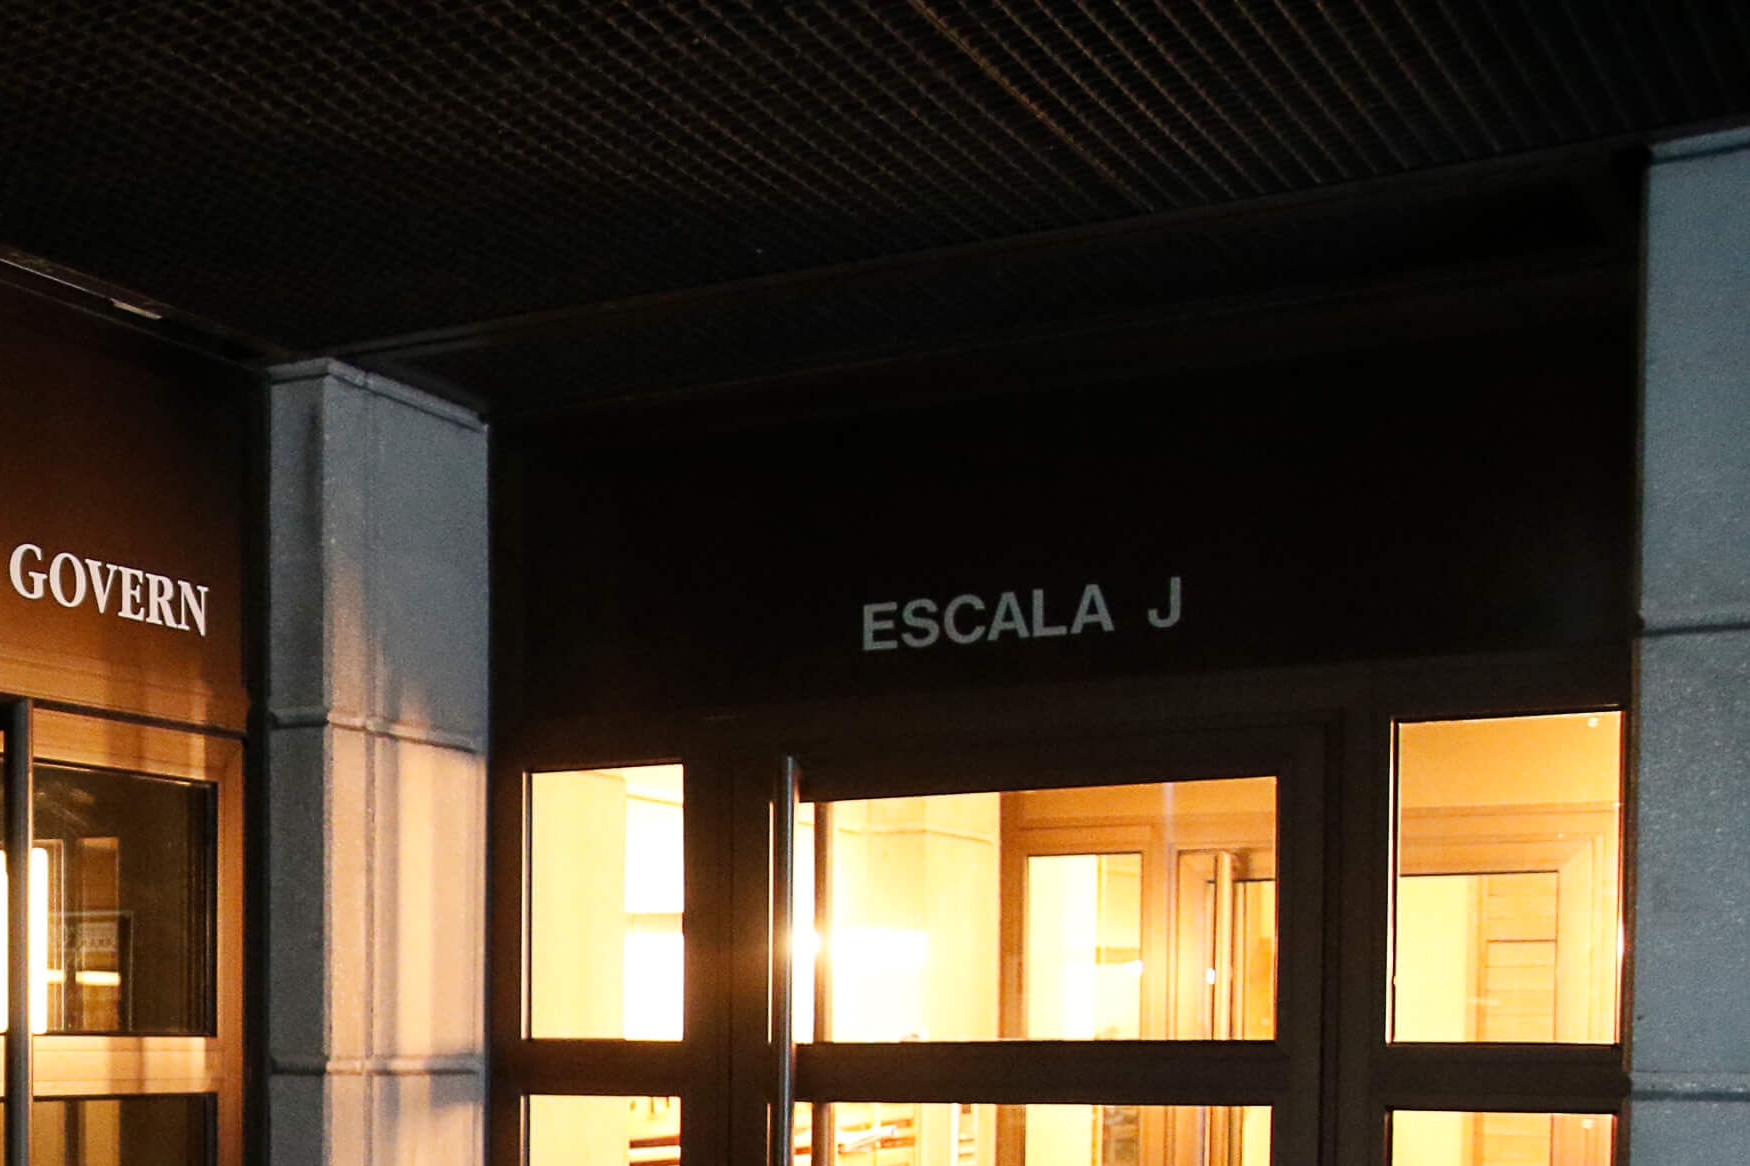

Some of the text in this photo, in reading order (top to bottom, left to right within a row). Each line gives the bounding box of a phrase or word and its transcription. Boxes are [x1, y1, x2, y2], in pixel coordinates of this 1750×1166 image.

[10, 543, 209, 637] GOVERN
[862, 576, 1183, 651] ESCALA J
